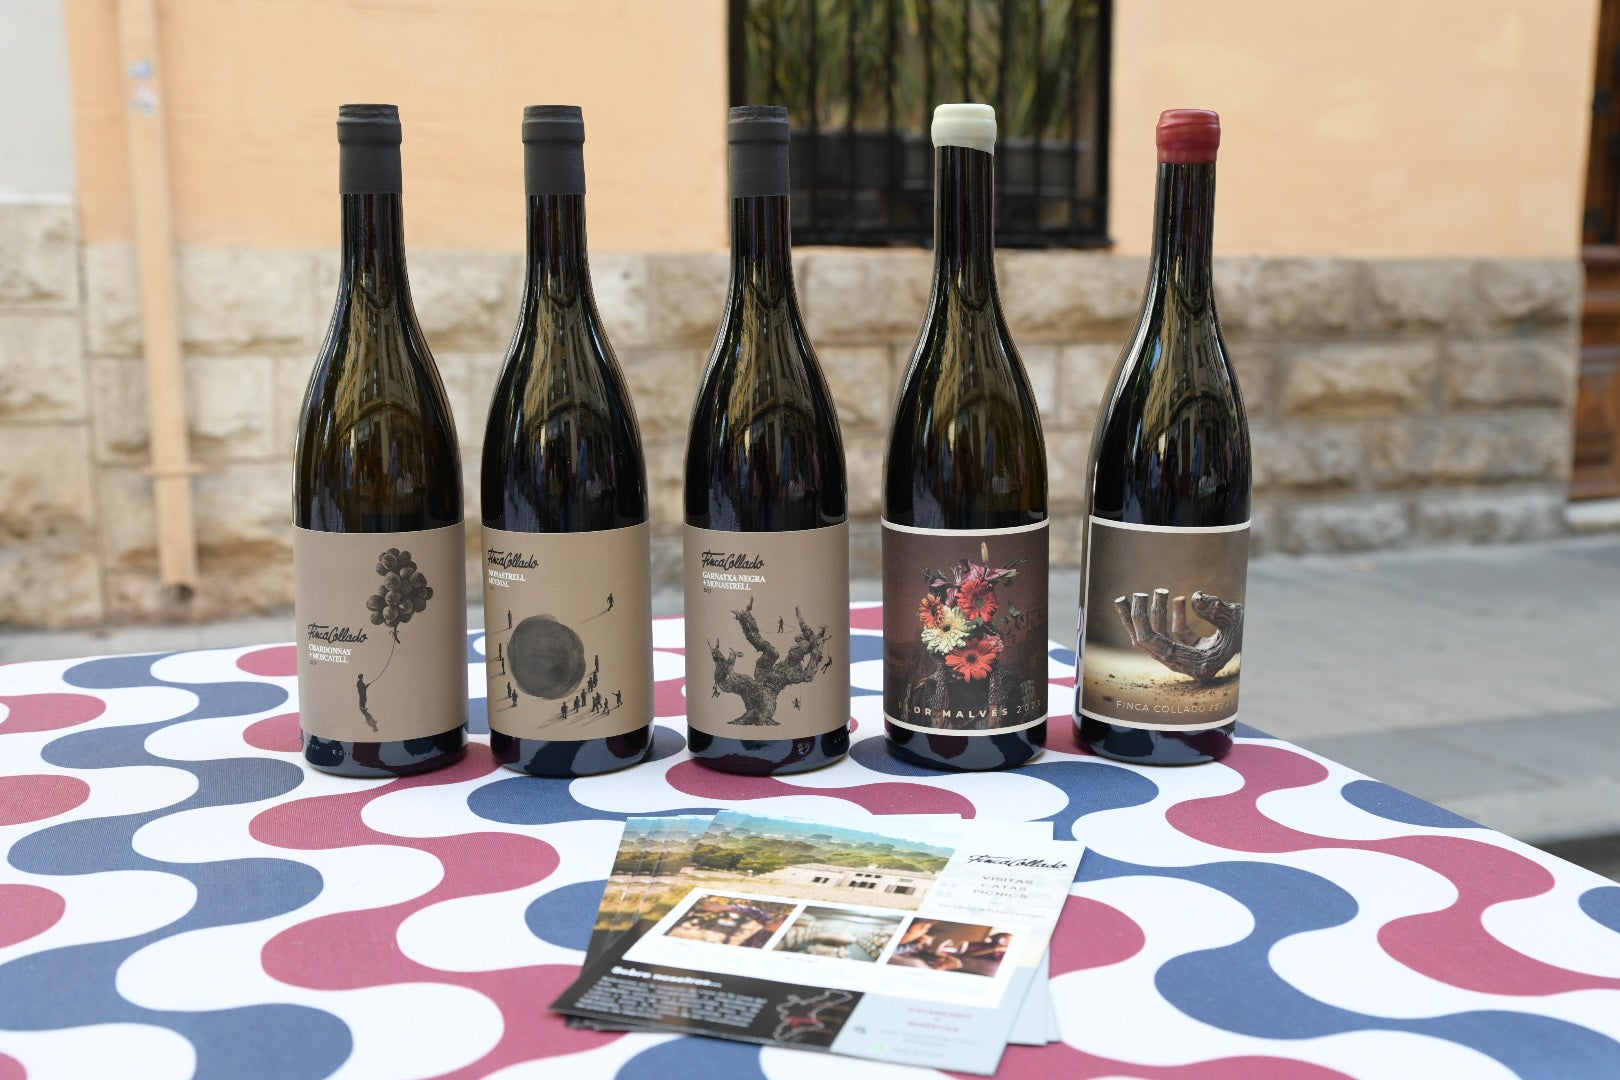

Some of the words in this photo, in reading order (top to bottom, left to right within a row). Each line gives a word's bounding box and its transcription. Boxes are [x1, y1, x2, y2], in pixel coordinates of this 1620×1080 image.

[702, 571, 738, 582] GARNATXA
[738, 574, 767, 583] NEGRA
[308, 643, 353, 656] CHARDONNAY
[1115, 700, 1150, 712] FINCA
[1153, 704, 1206, 714] COLLADO
[982, 875, 1034, 885] VISITAS
[980, 883, 1028, 892] CATAS
[973, 889, 1028, 899] PICNICS
